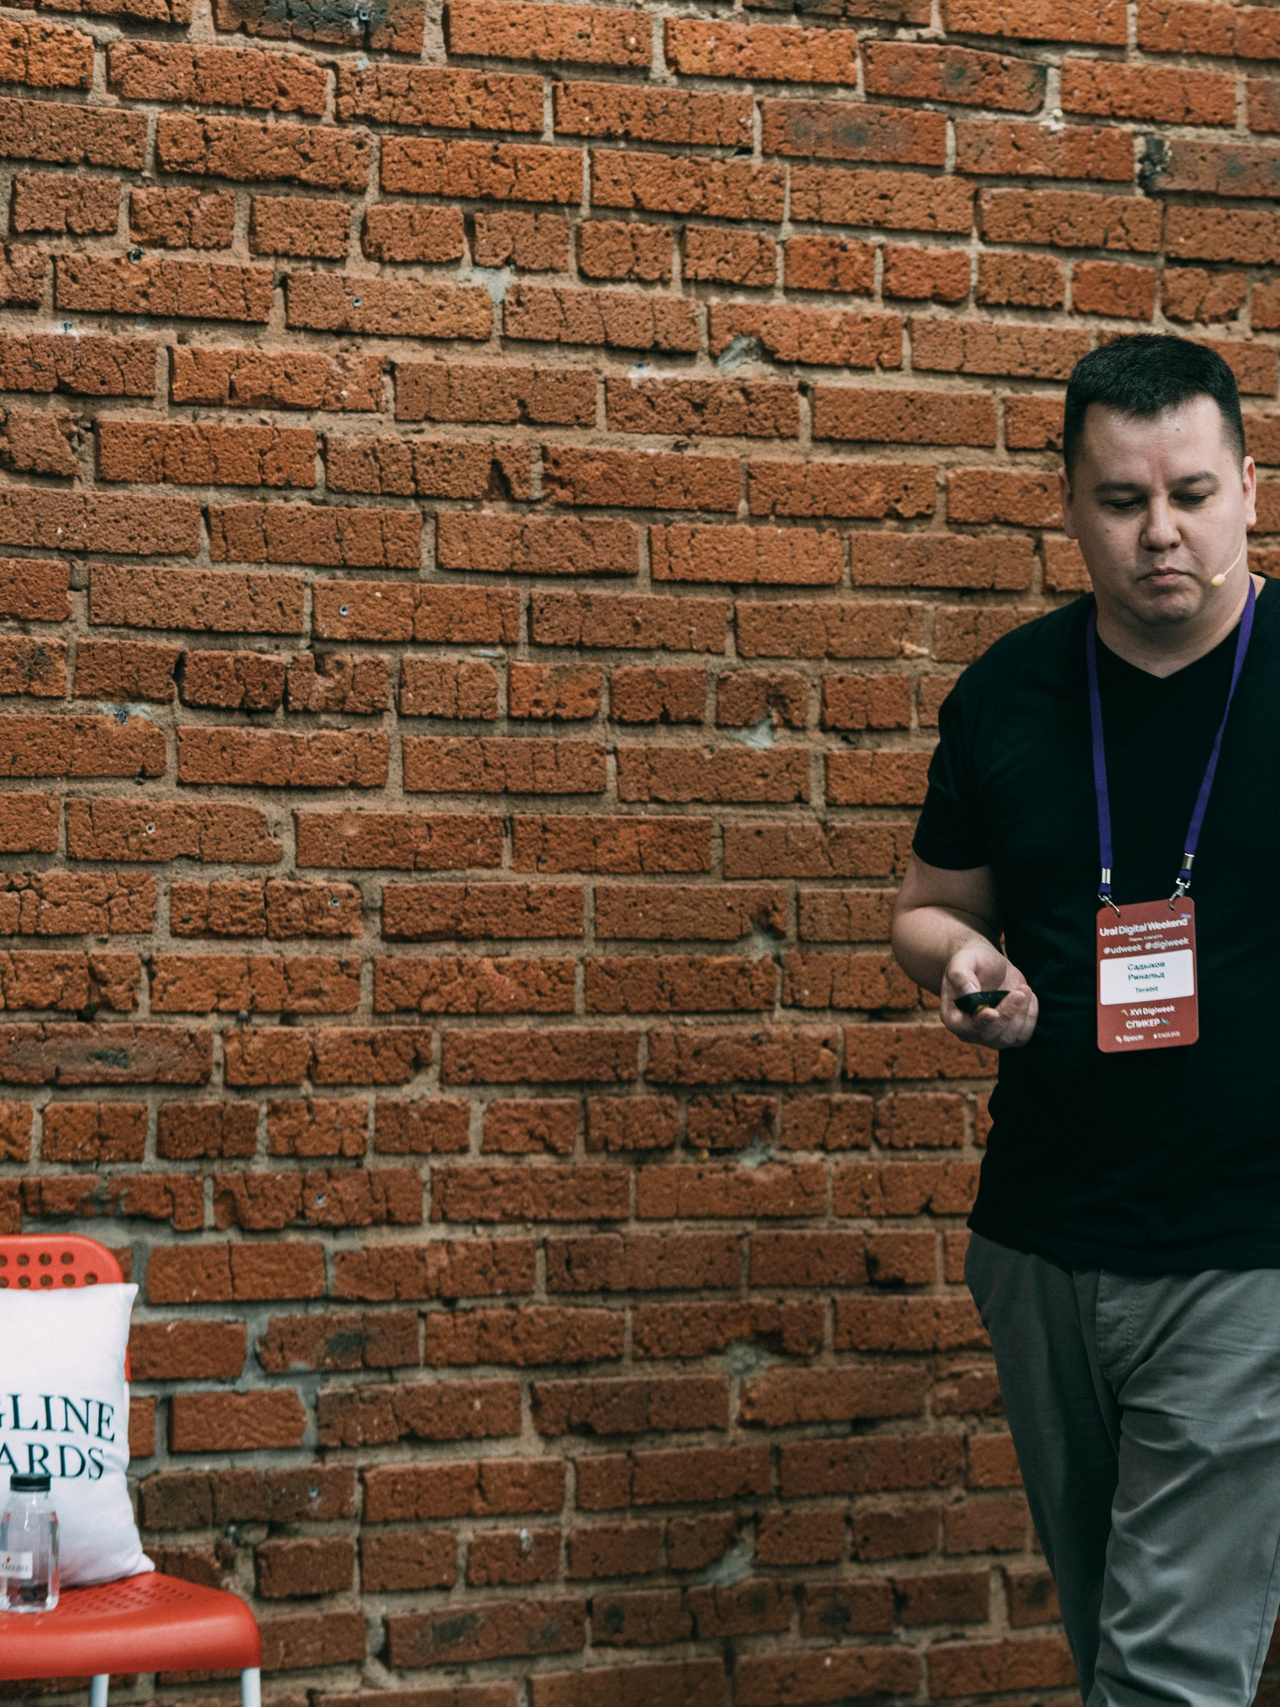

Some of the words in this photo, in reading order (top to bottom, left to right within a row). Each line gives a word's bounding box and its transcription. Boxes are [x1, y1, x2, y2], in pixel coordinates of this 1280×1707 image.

[1099, 926, 1118, 937] Ural
[1118, 923, 1147, 936] Digital
[1147, 918, 1188, 931] Weekend
[1145, 937, 1189, 950] #digiweek
[1125, 1018, 1160, 1029] СПИКЕР
[0, 1393, 116, 1443] LINE
